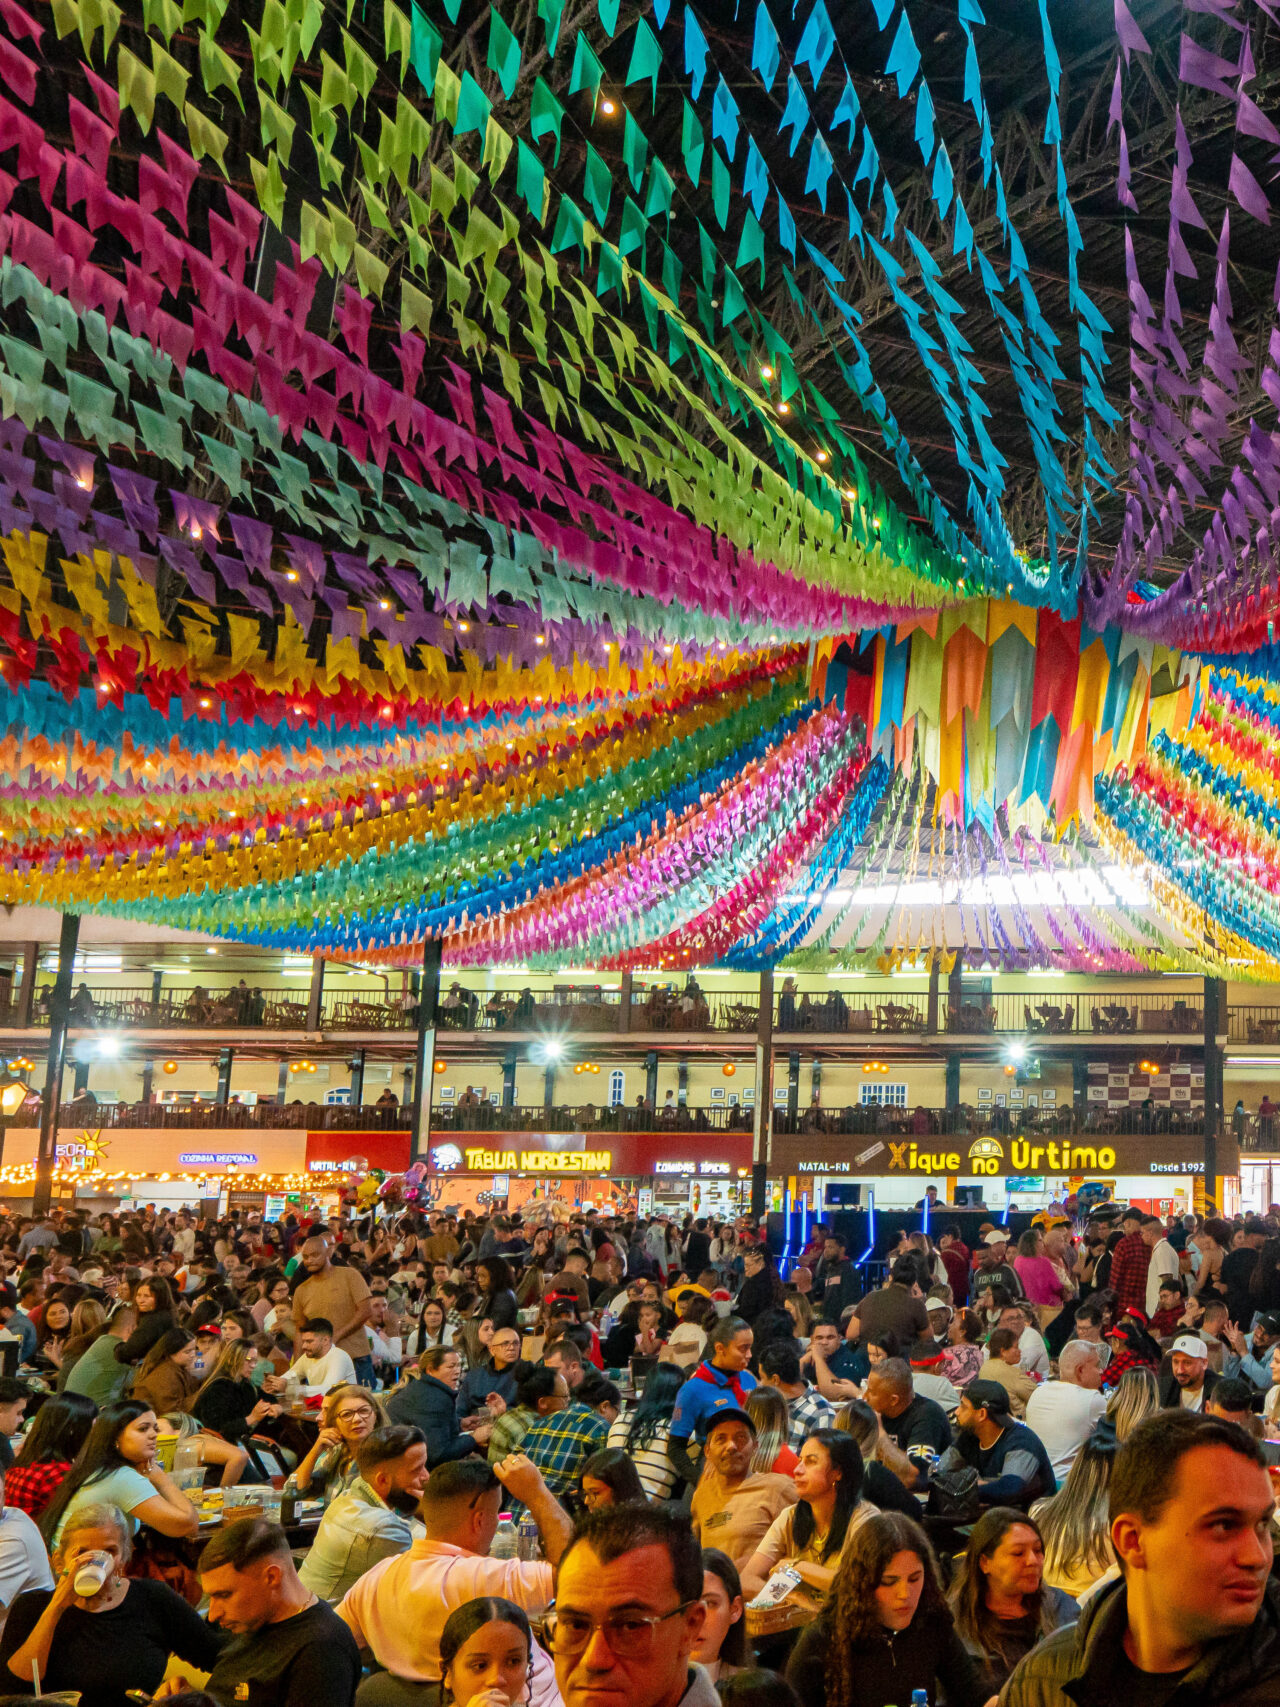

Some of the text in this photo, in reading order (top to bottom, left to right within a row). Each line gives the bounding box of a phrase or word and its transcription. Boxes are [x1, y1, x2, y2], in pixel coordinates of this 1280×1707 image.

[55, 1143, 86, 1156] BOR
[888, 1141, 961, 1174] Xique
[972, 1157, 999, 1175] no
[1011, 1136, 1116, 1170] Úrtimo
[310, 1160, 357, 1171] NATAL-RN
[521, 1150, 611, 1171] NORDESTINA
[655, 1161, 696, 1173] COMIDAS
[799, 1162, 850, 1172] NATAL-RN
[1151, 1161, 1205, 1173] Desde 1992
